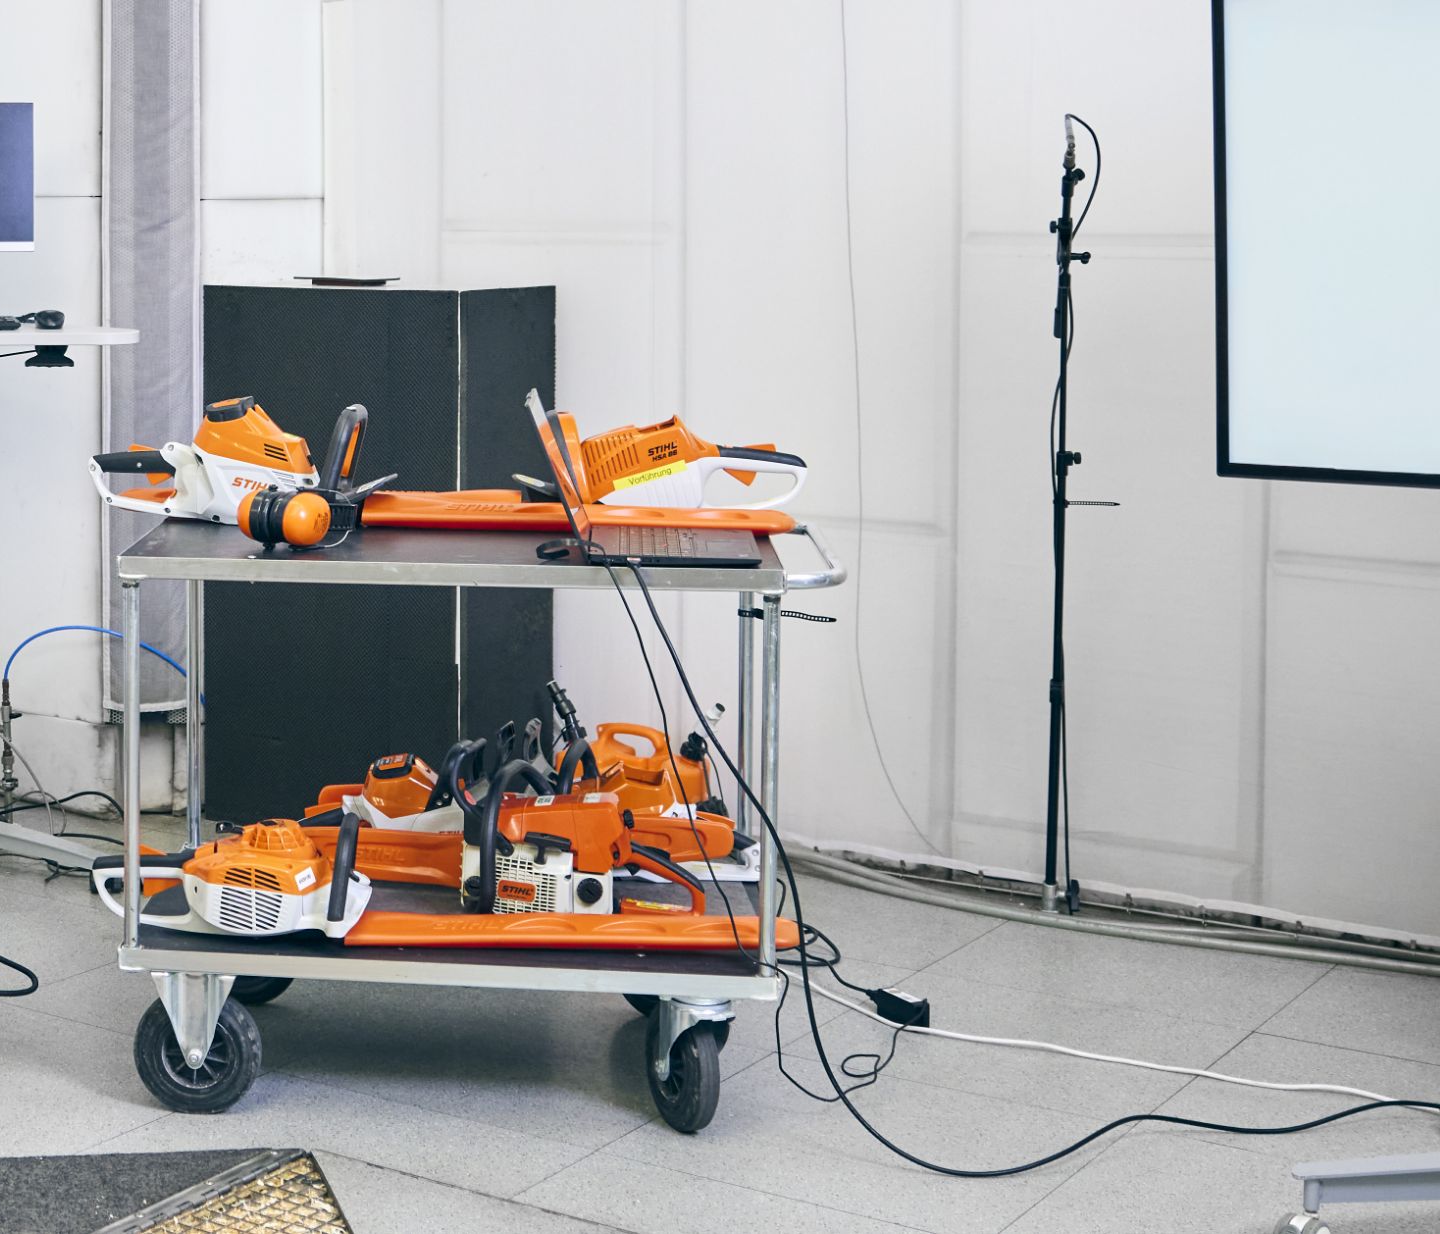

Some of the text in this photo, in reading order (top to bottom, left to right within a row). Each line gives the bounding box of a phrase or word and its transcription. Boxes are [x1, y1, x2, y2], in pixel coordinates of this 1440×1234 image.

[648, 441, 678, 457] STIHL
[652, 453, 667, 462] HSA
[232, 476, 268, 491] STIH
[627, 468, 672, 485] Vorführung
[502, 885, 532, 896] STIHL
